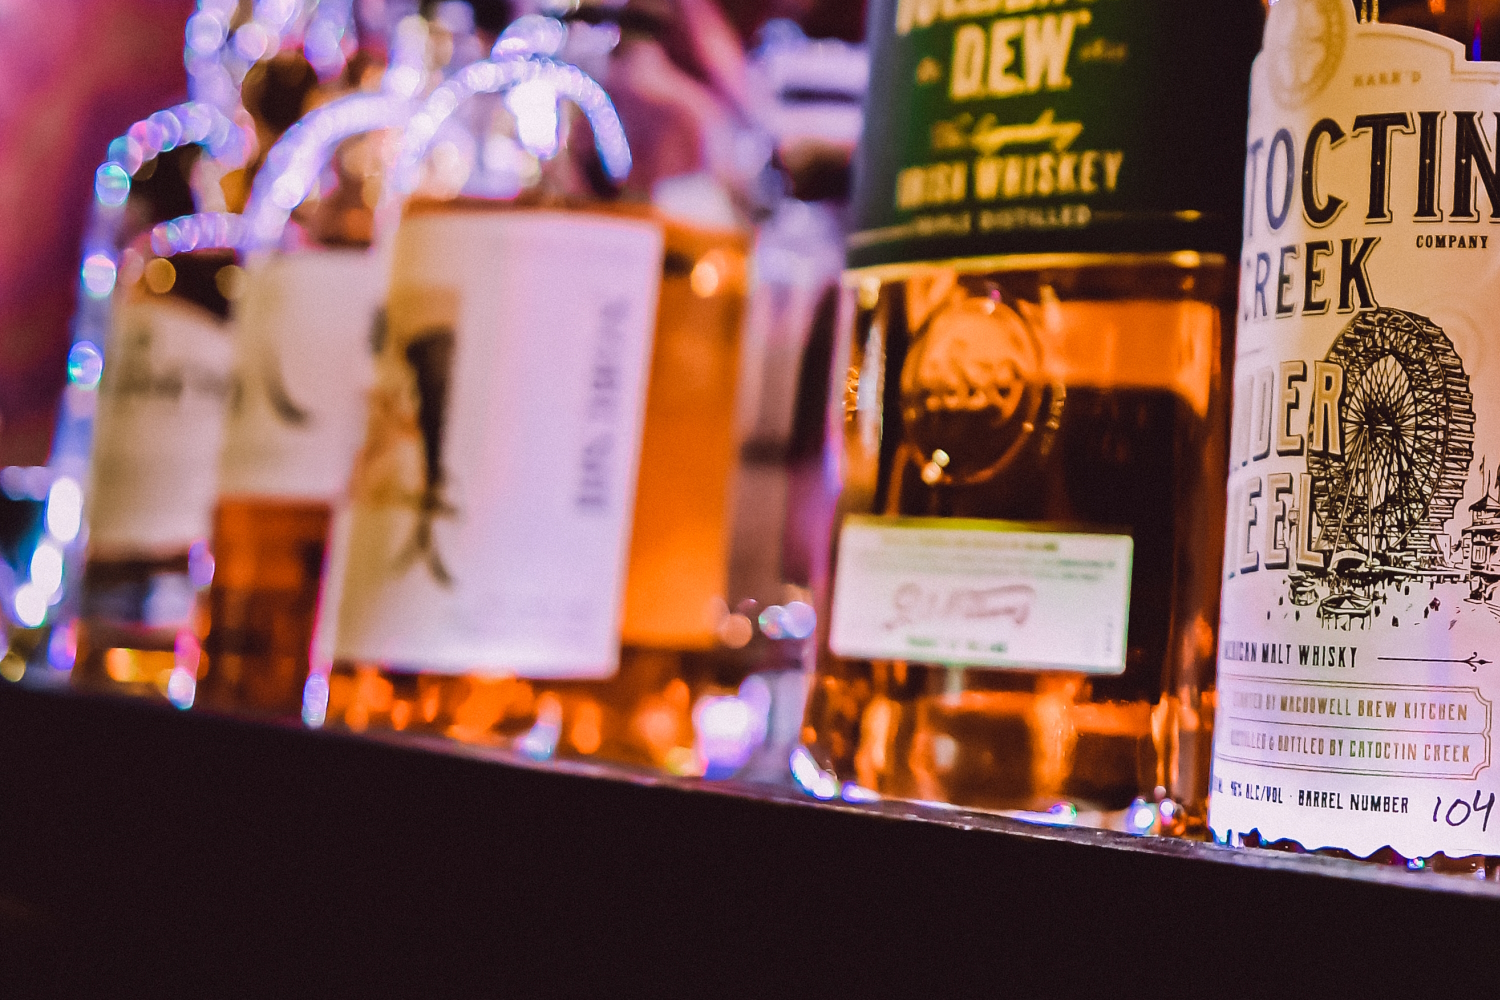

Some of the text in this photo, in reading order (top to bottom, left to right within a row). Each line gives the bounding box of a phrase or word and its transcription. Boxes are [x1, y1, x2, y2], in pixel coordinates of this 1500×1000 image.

[949, 10, 1086, 101] DEW
[974, 150, 1124, 200] WHISKEY
[1415, 233, 1490, 250] COMPANY
[1244, 236, 1382, 323] REEK
[1261, 642, 1292, 665] MALT
[1298, 644, 1358, 669] WHISKY
[1280, 695, 1352, 716] MACDOWELL
[1357, 699, 1398, 719] BREW
[1403, 702, 1468, 722] KITCHEN
[1277, 734, 1325, 756] BOTTLED
[1329, 738, 1344, 758] BY
[1349, 739, 1418, 762] CATOCTIN
[1423, 743, 1471, 764] CREEK
[1297, 788, 1345, 812] BARREL
[1349, 793, 1410, 815] NUMBER
